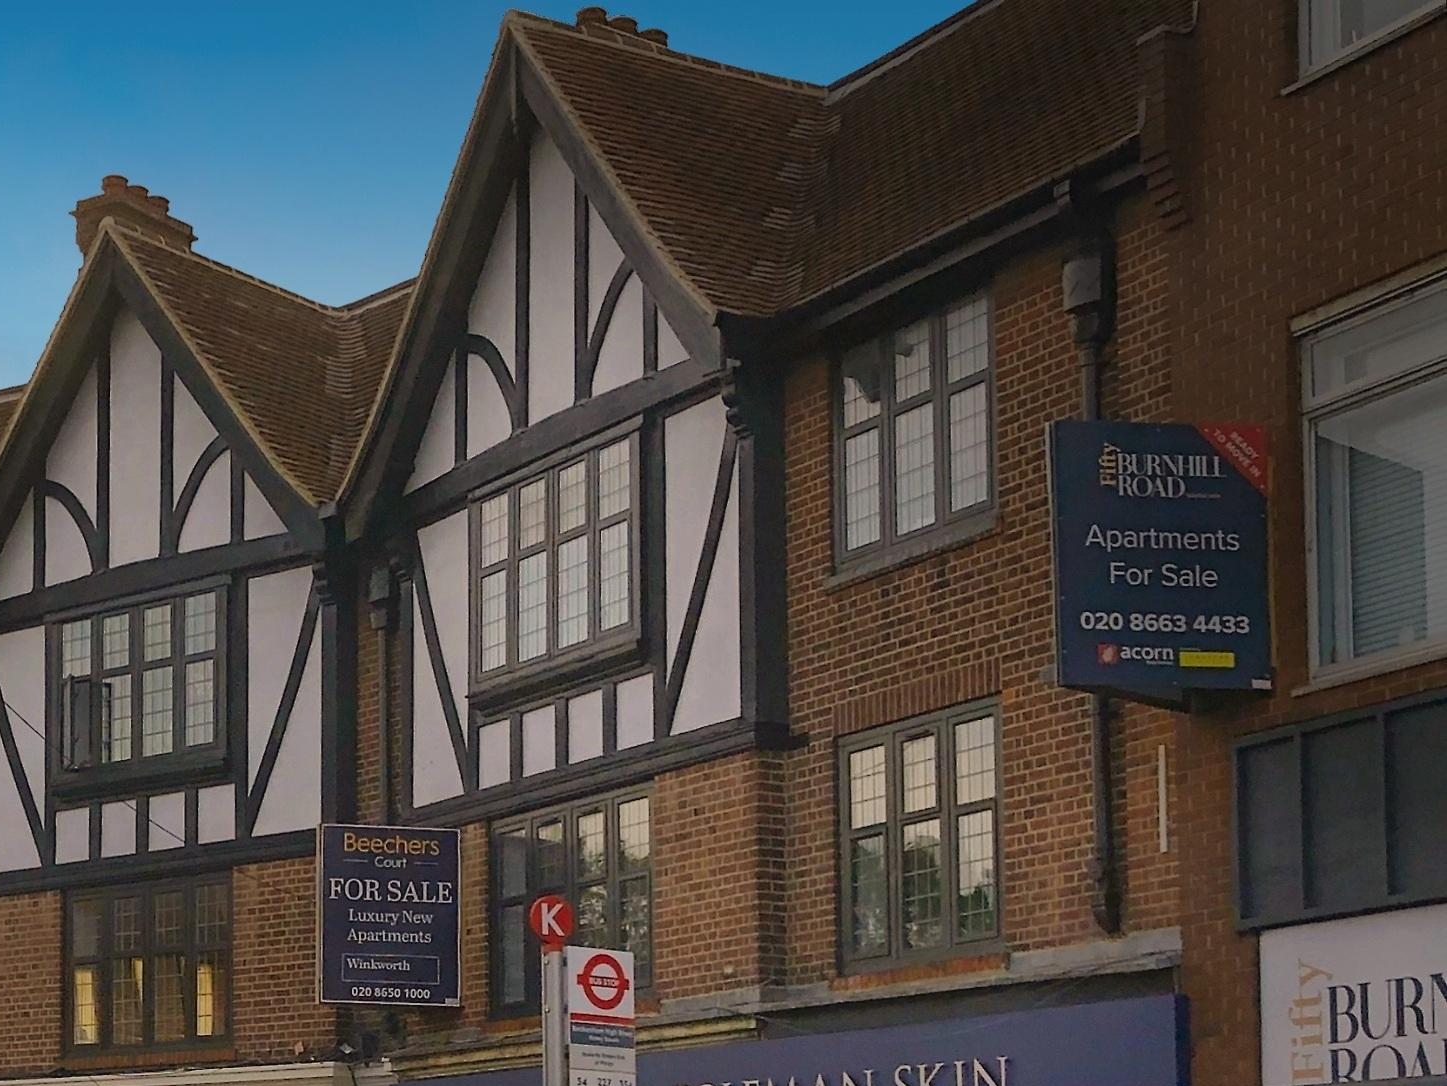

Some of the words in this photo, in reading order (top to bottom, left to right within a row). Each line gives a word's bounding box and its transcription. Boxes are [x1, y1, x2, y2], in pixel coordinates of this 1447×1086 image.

[1118, 453, 1227, 478] BURNHILL
[1118, 476, 1186, 498] ROAD
[1085, 524, 1241, 553] Apartments
[1109, 562, 1152, 586] For
[1161, 563, 1219, 588] Sale
[1080, 612, 1124, 631] 020
[1129, 613, 1187, 633] 8663
[1193, 615, 1250, 634] 4433
[1119, 644, 1174, 661] acorn
[344, 832, 440, 856] Beechers
[374, 856, 407, 869] Court
[329, 878, 382, 901] FOR
[387, 880, 453, 904] SALE
[348, 908, 400, 926] Luxury
[402, 911, 434, 924] New
[540, 903, 565, 937] K
[347, 928, 432, 944] Apartments
[346, 958, 411, 971] Winkworth
[351, 986, 372, 997] 020
[374, 987, 401, 998] 8650
[404, 988, 431, 999] 1000
[1289, 958, 1334, 1085] Fifty
[1328, 1039, 1447, 1084] ROA
[576, 1077, 588, 1086] 54
